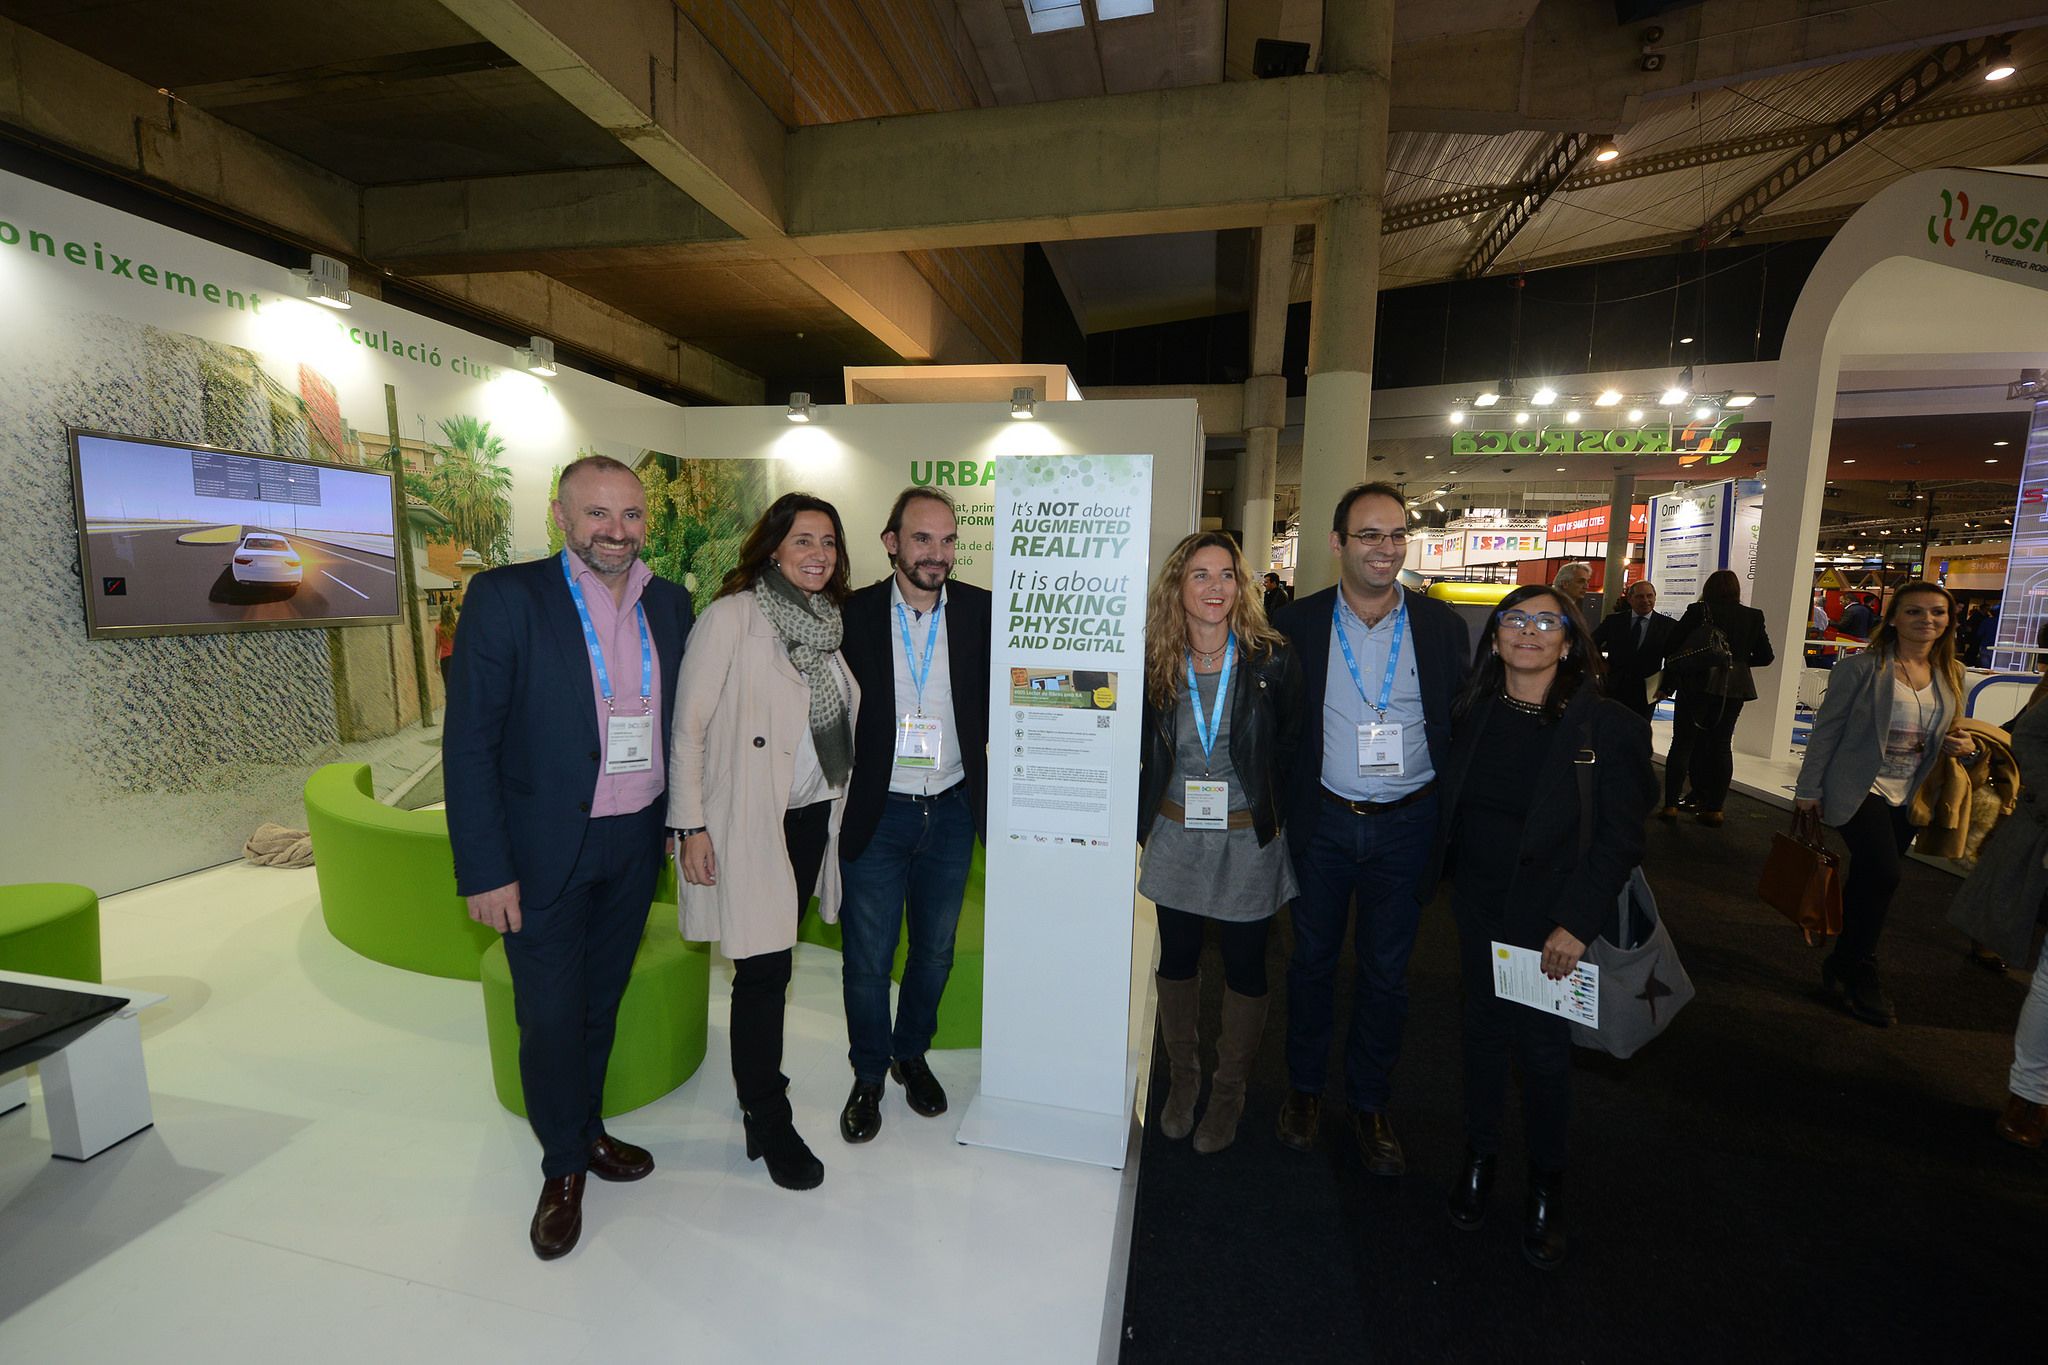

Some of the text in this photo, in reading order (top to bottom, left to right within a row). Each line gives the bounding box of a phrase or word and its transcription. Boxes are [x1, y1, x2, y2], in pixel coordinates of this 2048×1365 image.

[1991, 254, 2028, 270] TERBERG
[338, 322, 442, 367] culació
[1012, 501, 1133, 518] It's NOT about
[1010, 518, 1131, 535] AUGMENTED
[1573, 518, 1589, 530] SMART
[1589, 515, 1605, 527] CITIES
[1010, 535, 1131, 559] REALITY
[1471, 535, 1544, 551] ISRAEL
[1009, 570, 1129, 594] It is about
[1009, 592, 1127, 617] LINKING
[1008, 615, 1125, 637] PHYSICAL
[1008, 635, 1125, 654] AND DIGITAL
